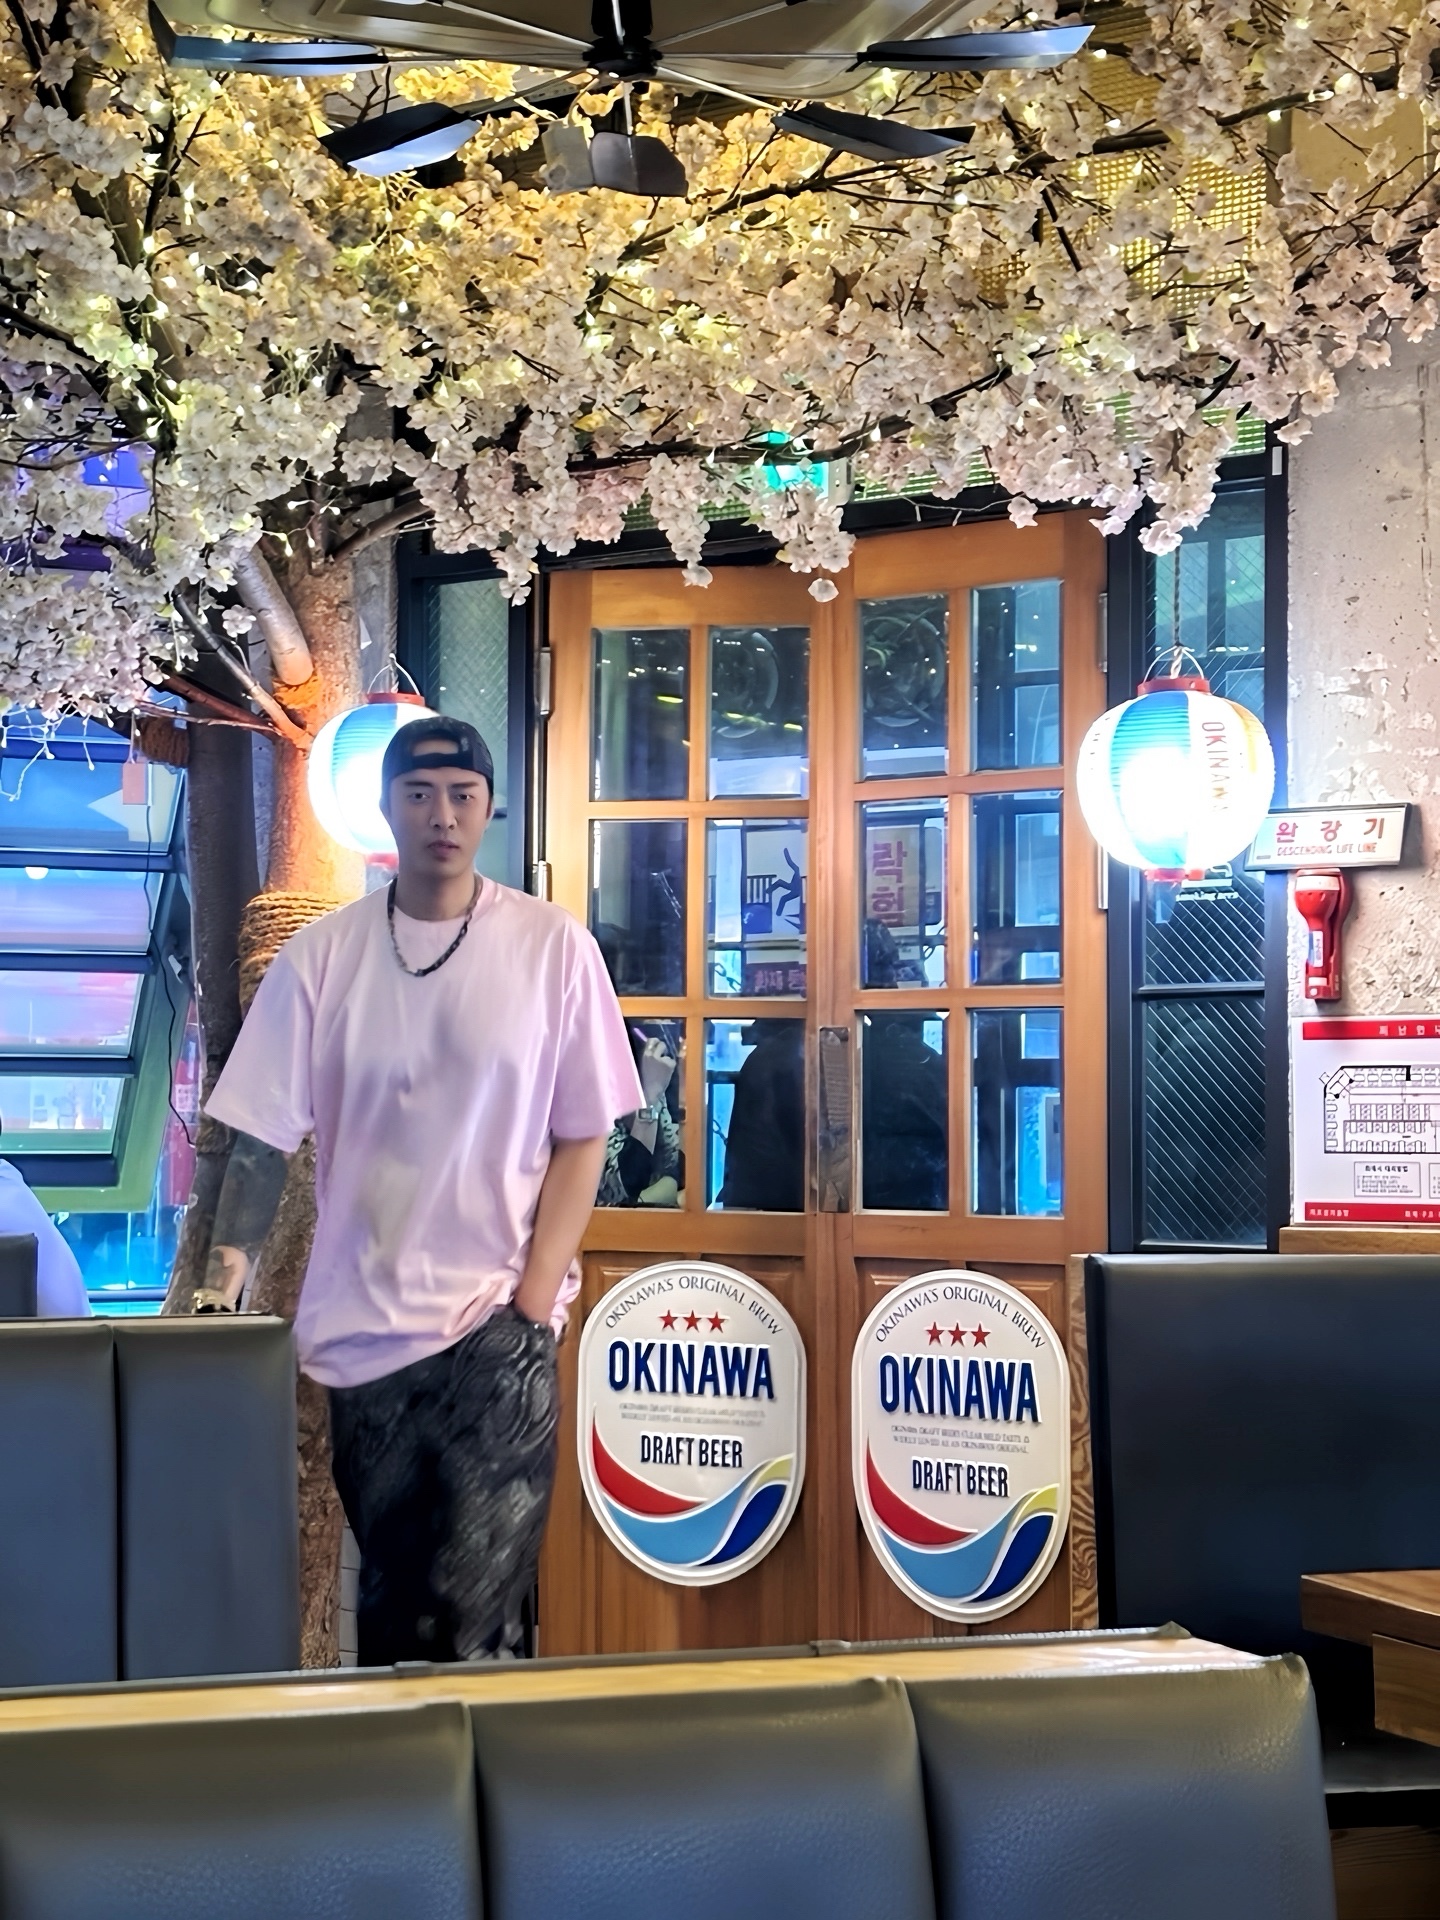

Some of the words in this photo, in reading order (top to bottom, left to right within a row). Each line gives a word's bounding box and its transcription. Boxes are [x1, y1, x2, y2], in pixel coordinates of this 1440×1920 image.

[605, 1278, 674, 1328] OKINAWA'S
[678, 1276, 745, 1306] ORIGINAL
[748, 1300, 783, 1335] BREW
[876, 1288, 939, 1342] OKINAWA'S
[943, 1286, 1008, 1317] ORIGINAL
[1011, 1311, 1046, 1349] BREW
[608, 1339, 776, 1399] OKINAWA
[879, 1354, 1041, 1423] OKINAWA
[640, 1433, 696, 1466] DRAFT
[699, 1437, 744, 1468] BEER
[912, 1459, 964, 1495] DRAFT
[966, 1464, 1010, 1498] BEER
